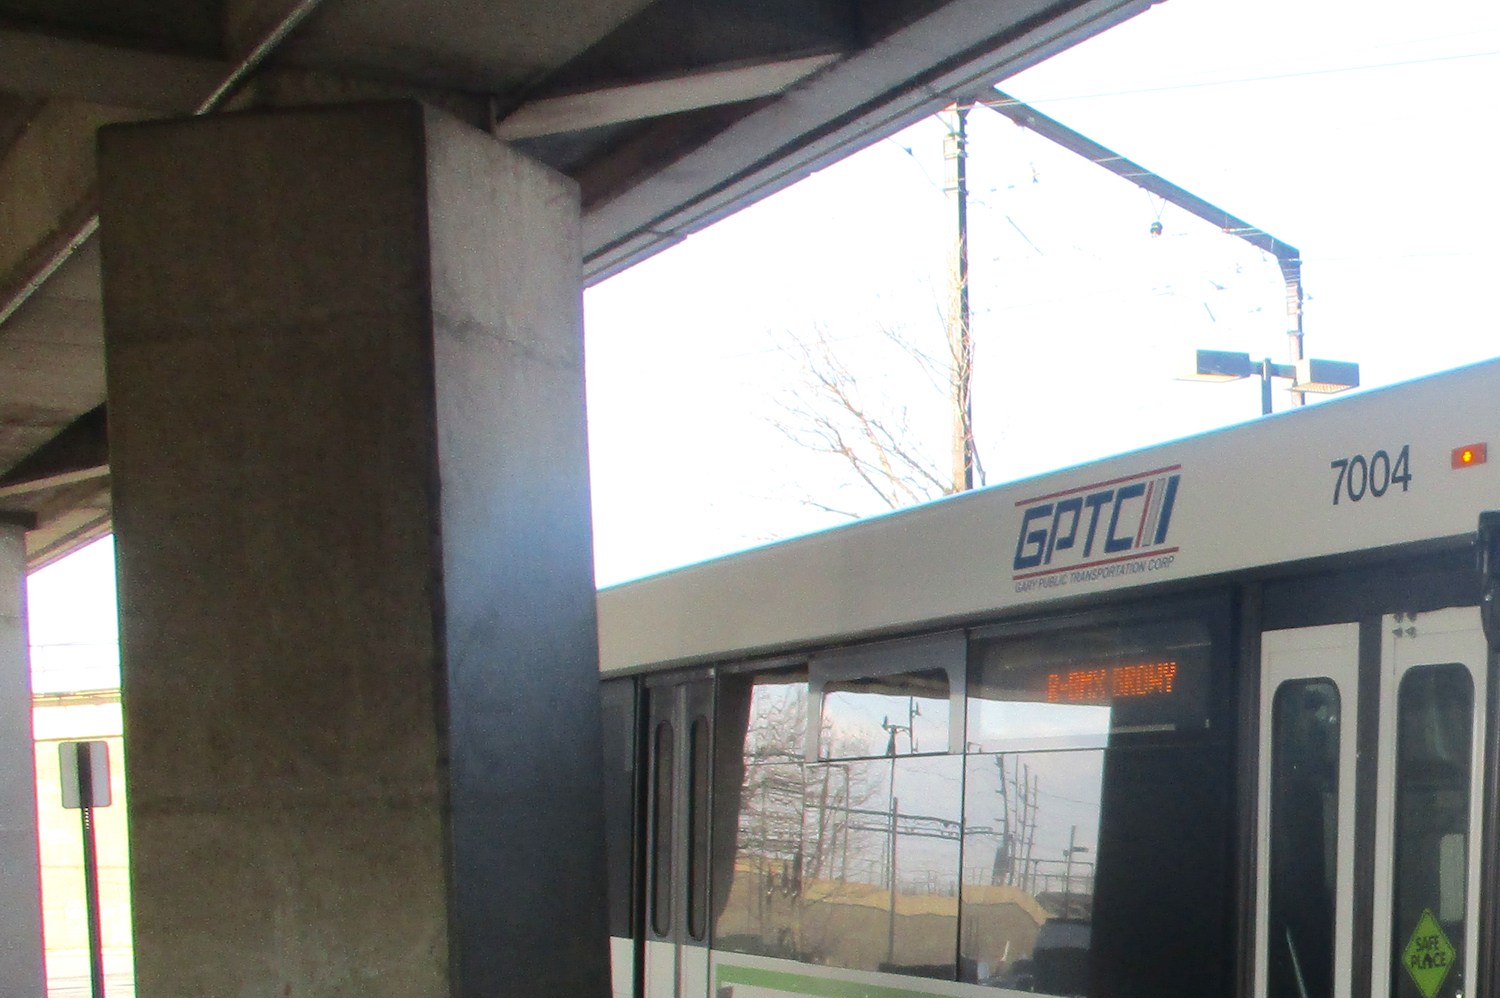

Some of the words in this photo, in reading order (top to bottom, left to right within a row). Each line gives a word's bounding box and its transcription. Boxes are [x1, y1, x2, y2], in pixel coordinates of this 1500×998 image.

[1330, 444, 1412, 506] 7004
[1015, 577, 1037, 594] GARY
[1038, 573, 1068, 589] PUBLIC
[1070, 560, 1146, 584] TRANSPORTATION
[1148, 555, 1175, 572] CORP
[1416, 935, 1440, 953] SAFE
[1411, 951, 1447, 970] PLACE
